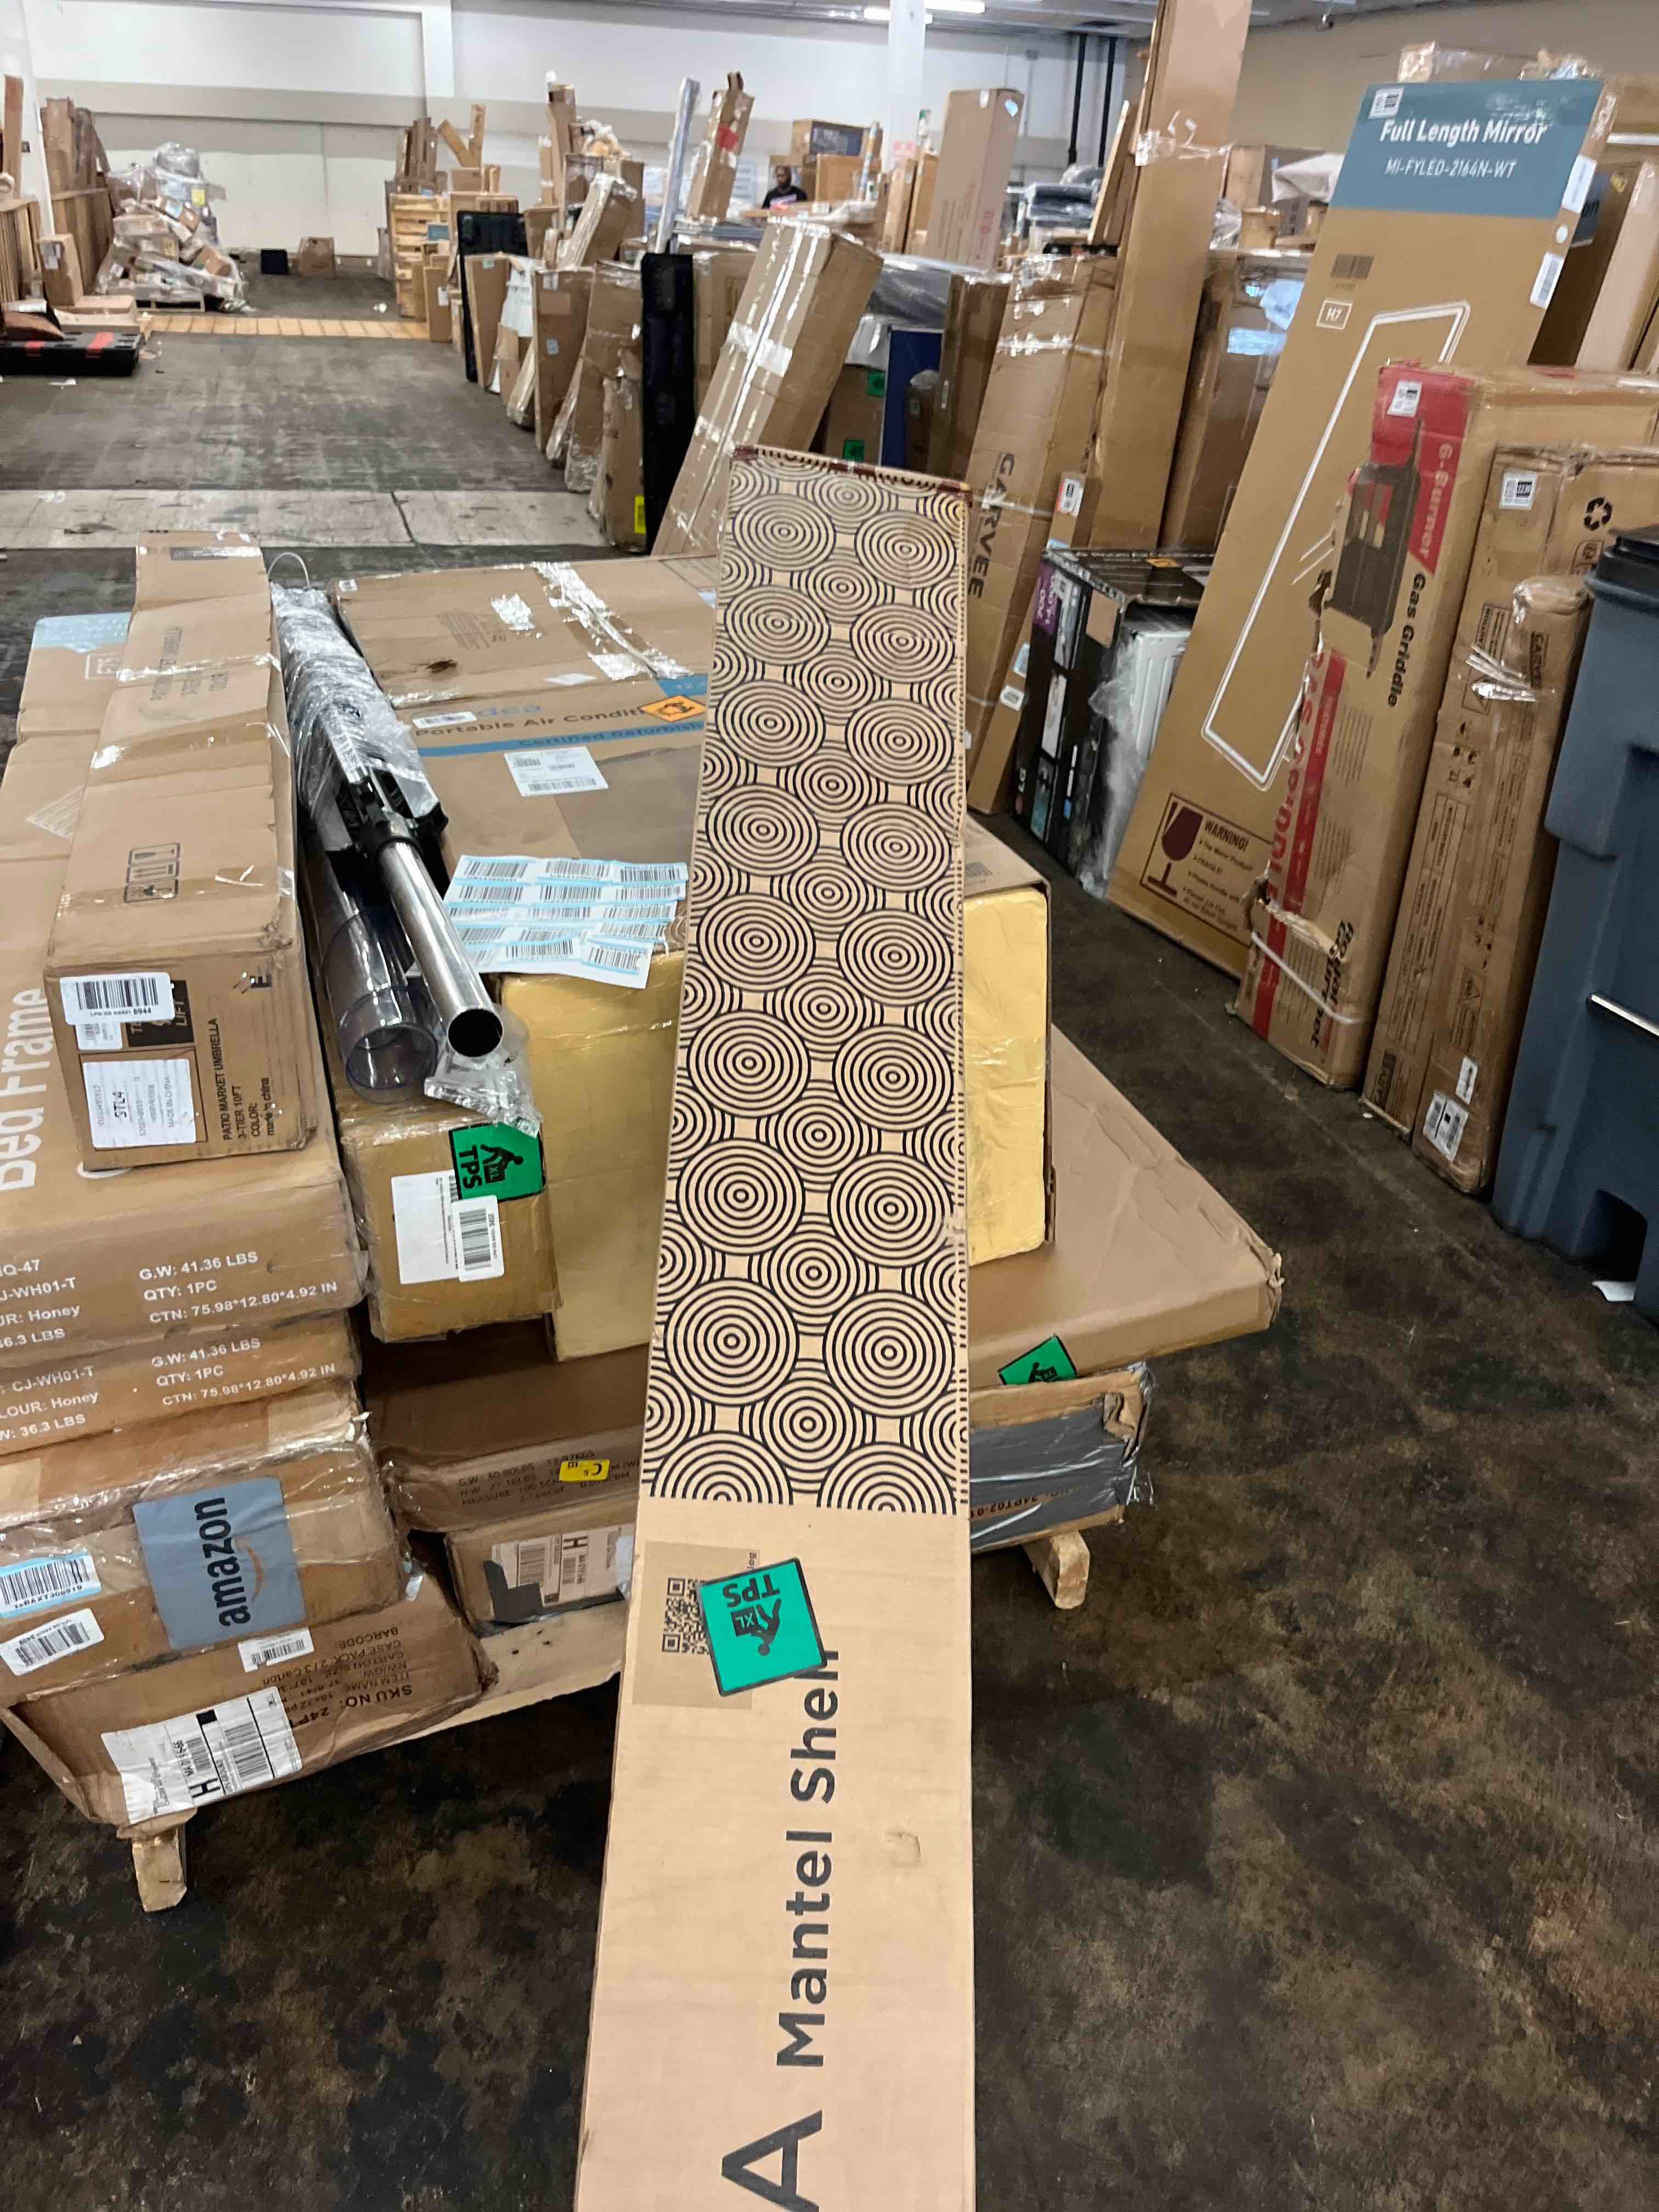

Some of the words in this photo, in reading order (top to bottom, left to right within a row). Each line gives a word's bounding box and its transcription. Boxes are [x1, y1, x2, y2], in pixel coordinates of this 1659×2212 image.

[1380, 118, 1415, 142] Full
[1417, 119, 1480, 148] Length
[1482, 120, 1549, 145] Mirror
[1407, 573, 1426, 619] Gas
[1387, 624, 1415, 708] Griddle
[415, 720, 515, 737] Portable
[523, 715, 554, 729] Air
[1204, 820, 1250, 852] WARNING!
[207, 1018, 224, 1071] UMBRELLA
[215, 1073, 229, 1113] MARKET
[232, 1085, 242, 1107] 10FT
[219, 1113, 232, 1141] PATIO
[234, 1106, 246, 1139] 3-TIER
[459, 1145, 483, 1189] TPS
[180, 1257, 222, 1274] 41.36
[225, 1251, 259, 1267] LBS
[27, 1305, 81, 1322] Honey
[149, 1308, 188, 1323] CTN:
[321, 1282, 337, 1293] IN
[143, 1285, 182, 1301] QTY:
[187, 1279, 218, 1296] 1PC
[31, 1328, 66, 1344] LBS
[12, 1365, 95, 1393] CJ-WH01-T
[189, 1344, 227, 1361] 41.36
[230, 1338, 261, 1353] LBS
[20, 1421, 50, 1437] 36.3
[53, 1413, 86, 1429] LBS
[162, 1391, 197, 1406] CTN:
[320, 1362, 336, 1374] IN
[50, 1391, 99, 1410] Honey
[156, 1372, 191, 1387] QTY:
[194, 1364, 225, 1380] 1PC
[563, 1536, 588, 1550] H
[194, 1497, 251, 1627] amazon
[722, 1573, 781, 1609] TPS
[735, 1613, 755, 1628] XL
[263, 1668, 302, 1685] Carton
[376, 1685, 413, 1702] SKU
[790, 1650, 838, 1804] Shel
[188, 1777, 222, 1799] H
[776, 1829, 834, 2068] Mantel
